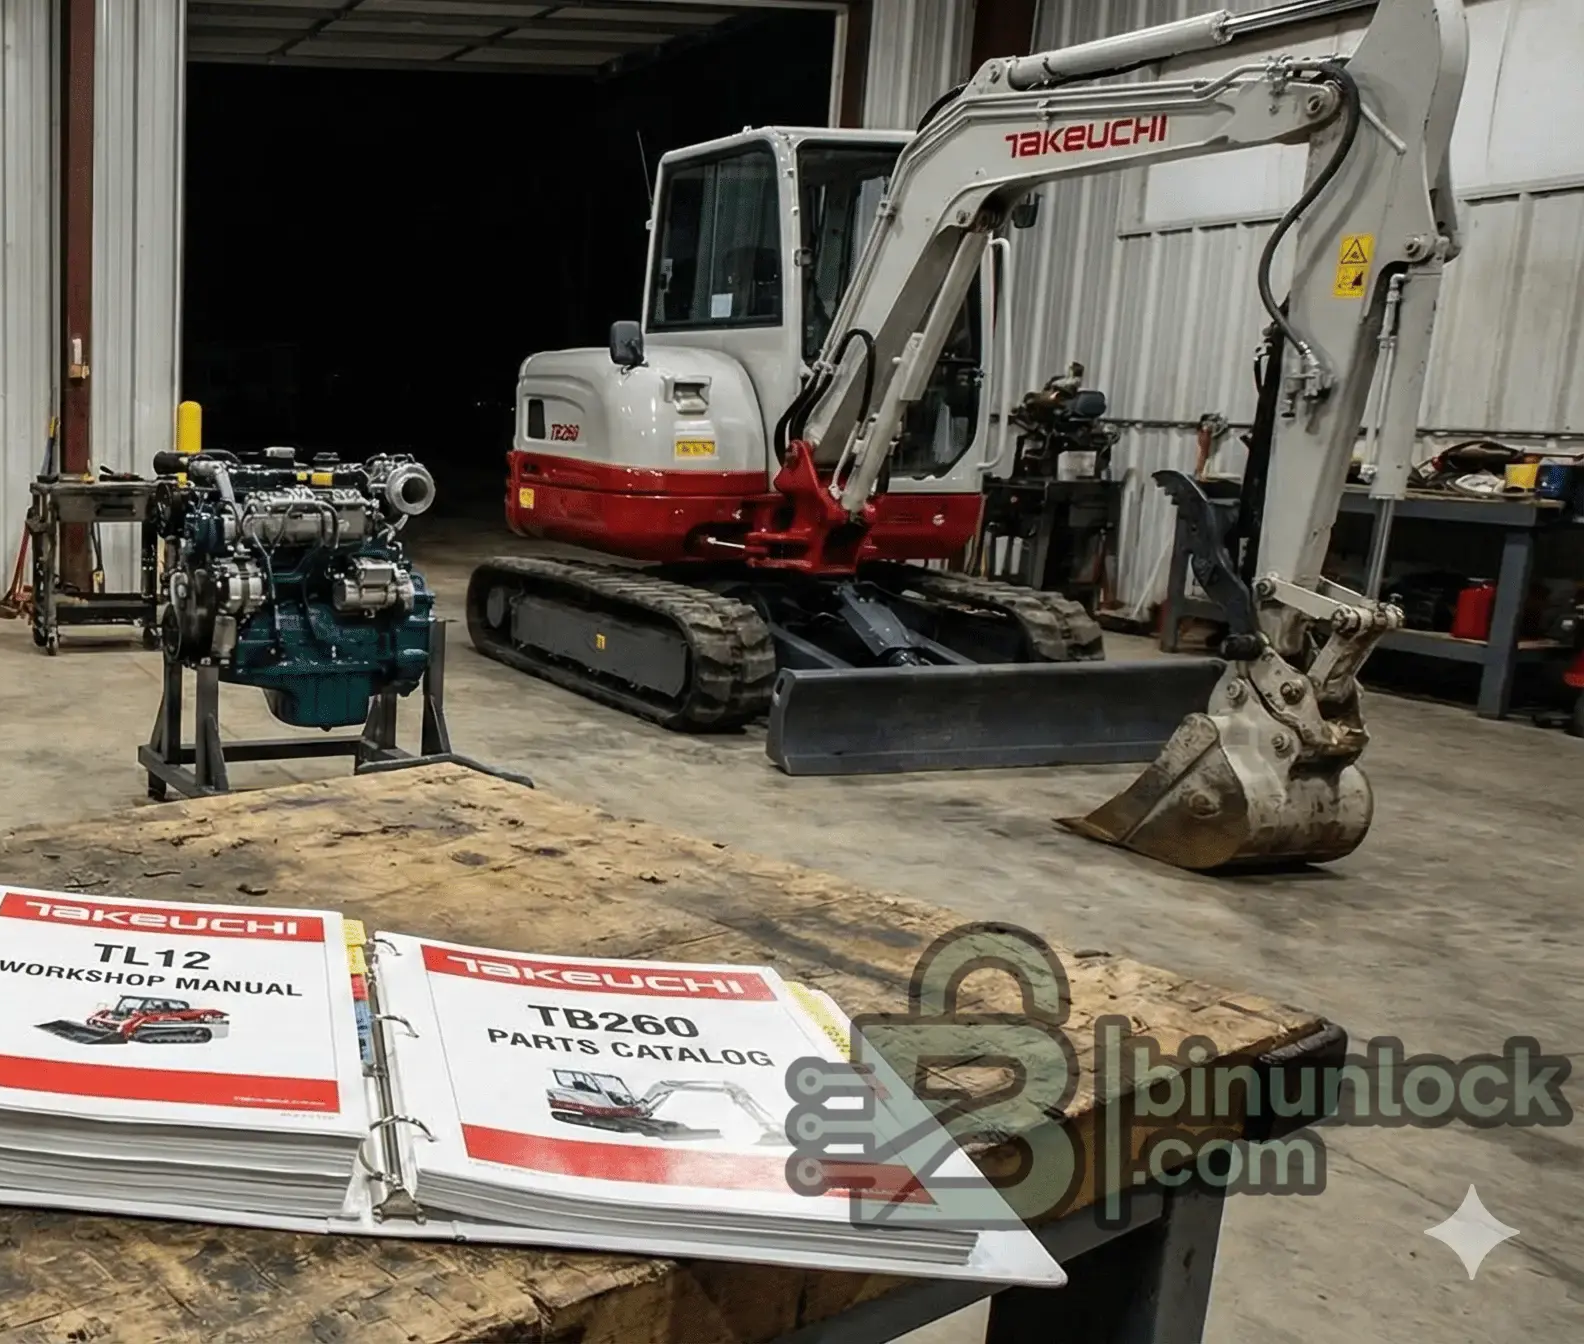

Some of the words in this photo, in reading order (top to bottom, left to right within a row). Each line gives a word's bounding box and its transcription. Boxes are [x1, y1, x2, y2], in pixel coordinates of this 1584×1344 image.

[94, 942, 212, 970] TL12
[0, 960, 166, 988] WORKSHOP
[174, 977, 303, 997] MANUAL
[527, 1004, 700, 1039] TB260
[487, 1028, 601, 1056] PARTS
[610, 1041, 775, 1068] CATALOG
